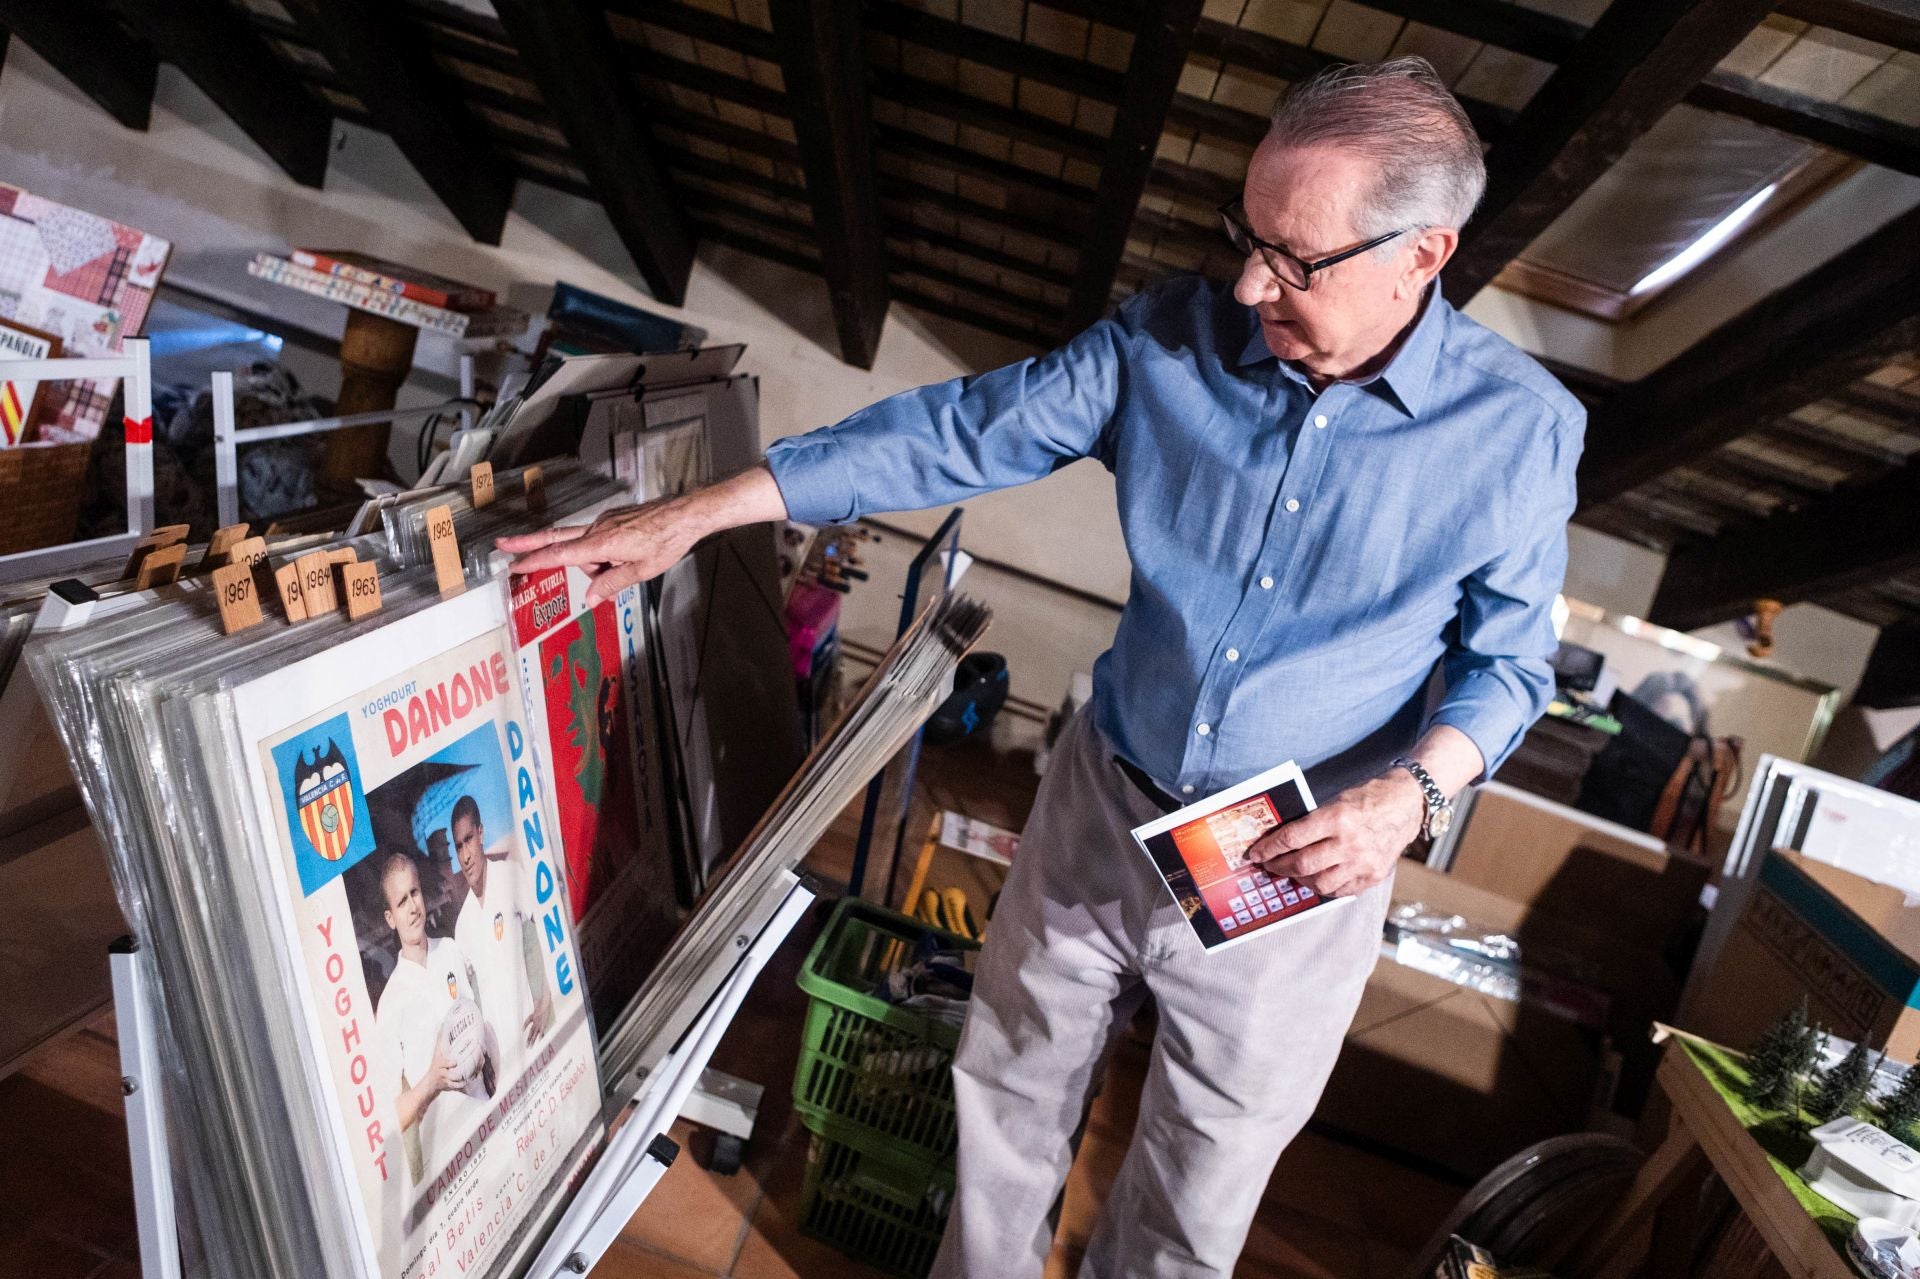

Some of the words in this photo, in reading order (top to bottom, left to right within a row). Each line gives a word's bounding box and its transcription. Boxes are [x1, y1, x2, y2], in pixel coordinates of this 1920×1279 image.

[476, 473, 493, 490] 1972
[433, 520, 453, 541] 1962
[224, 577, 251, 606] 1967
[306, 567, 331, 591] 1964
[352, 577, 376, 597] 1963
[362, 680, 417, 719] YOGHOURT
[383, 652, 510, 758] DANONE
[301, 784, 328, 804] VALENCIA
[504, 720, 574, 997] DANONE
[317, 916, 388, 1181] YOGHOURT
[426, 1141, 473, 1206] CAMPO
[478, 1116, 496, 1143] DE
[499, 1044, 555, 1117] MESTALLA
[446, 1197, 484, 1251] Betis
[457, 1195, 513, 1273] Valencia
[533, 1149, 545, 1171] de
